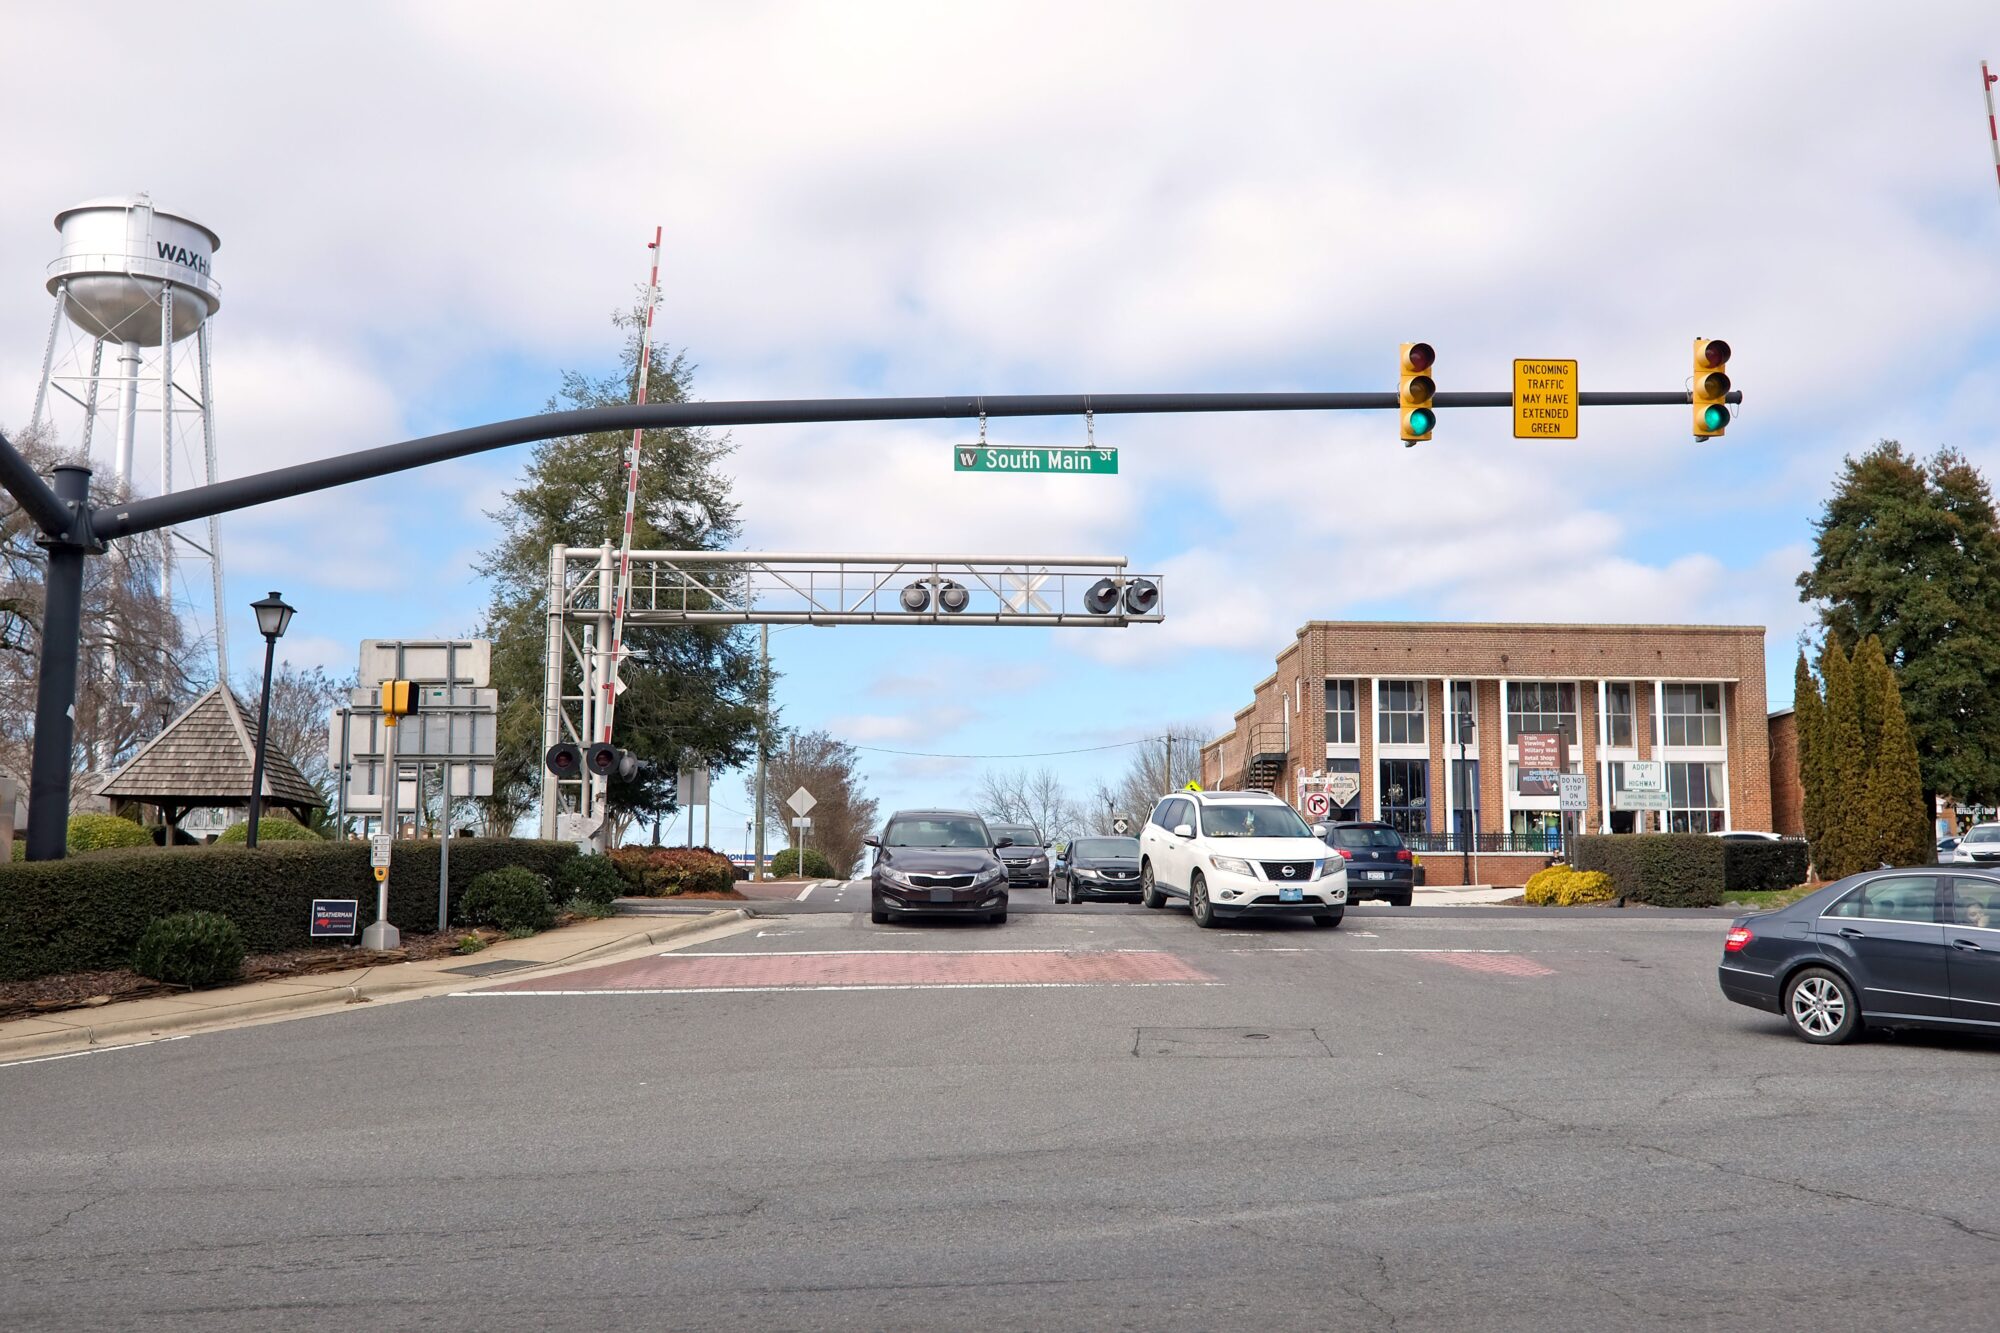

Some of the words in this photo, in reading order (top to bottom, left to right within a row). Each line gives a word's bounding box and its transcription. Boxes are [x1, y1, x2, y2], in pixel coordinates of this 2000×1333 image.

[1523, 365, 1568, 374] ONCOMING
[1528, 379, 1564, 389] TRAFFIC
[1522, 394, 1541, 404] MAY
[1545, 394, 1568, 404] HAVE
[1523, 408, 1568, 418] EXTENDED
[1531, 423, 1560, 433] GREEN
[986, 450, 1040, 469] South
[1048, 451, 1091, 470] Main
[1099, 450, 1112, 461] St
